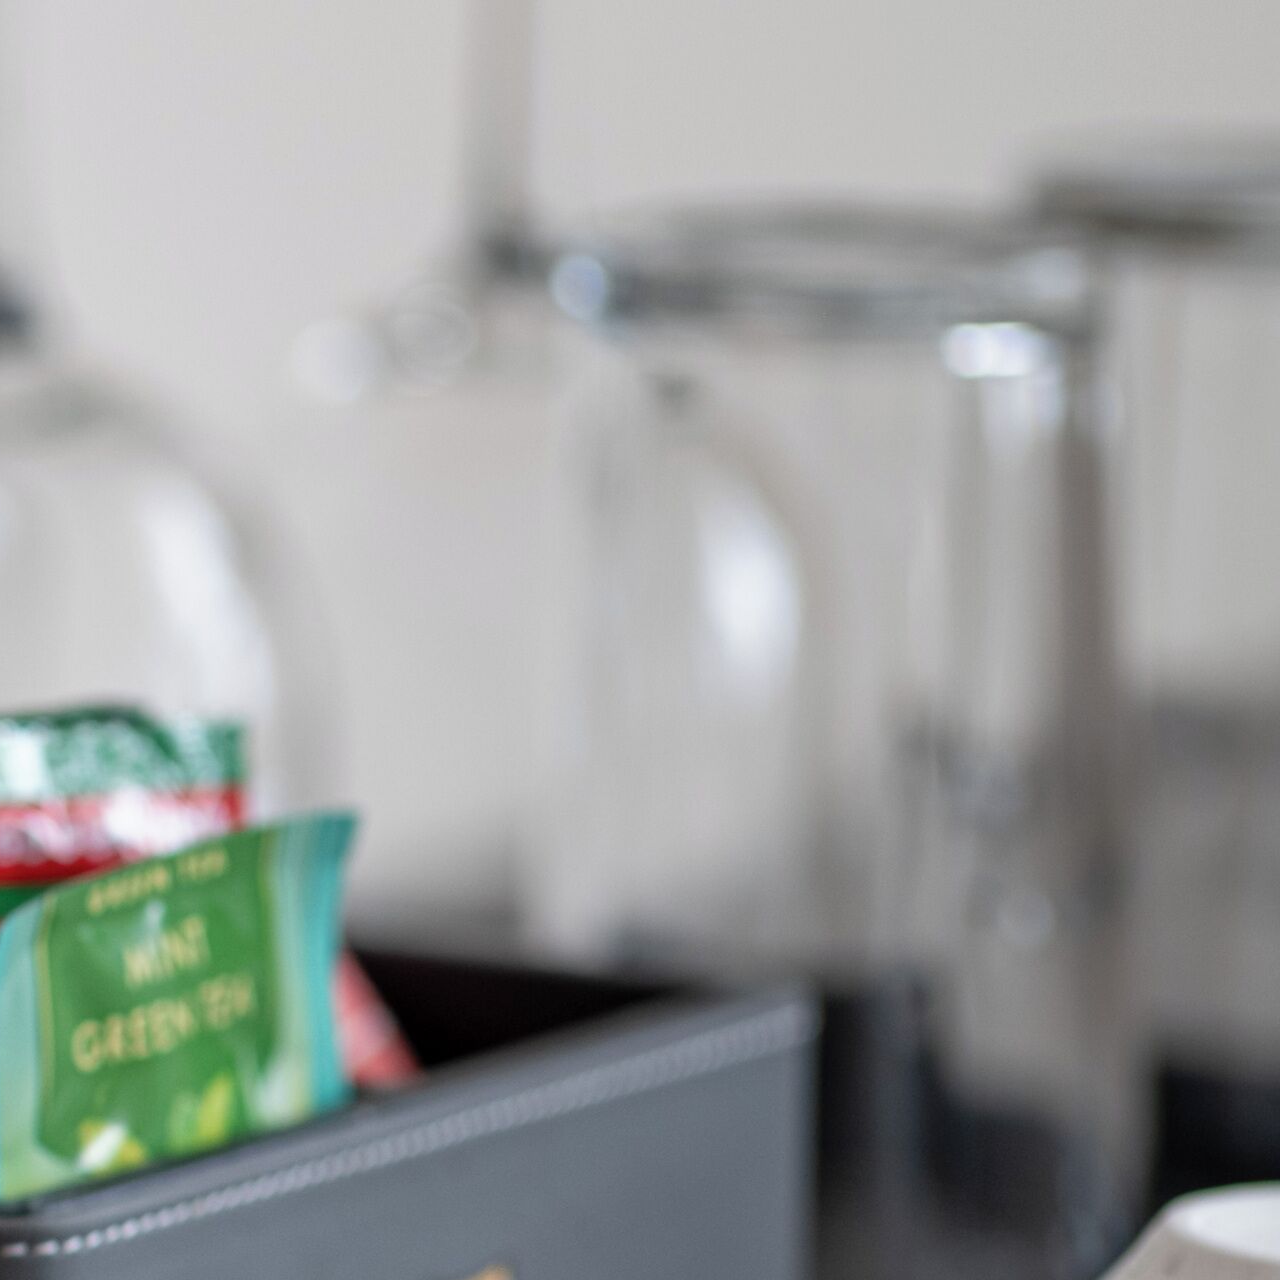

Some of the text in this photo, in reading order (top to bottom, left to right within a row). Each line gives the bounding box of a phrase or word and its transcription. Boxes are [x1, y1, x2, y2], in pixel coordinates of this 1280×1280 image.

[124, 915, 210, 988] MINT
[72, 974, 257, 1073] GREEN TEA
